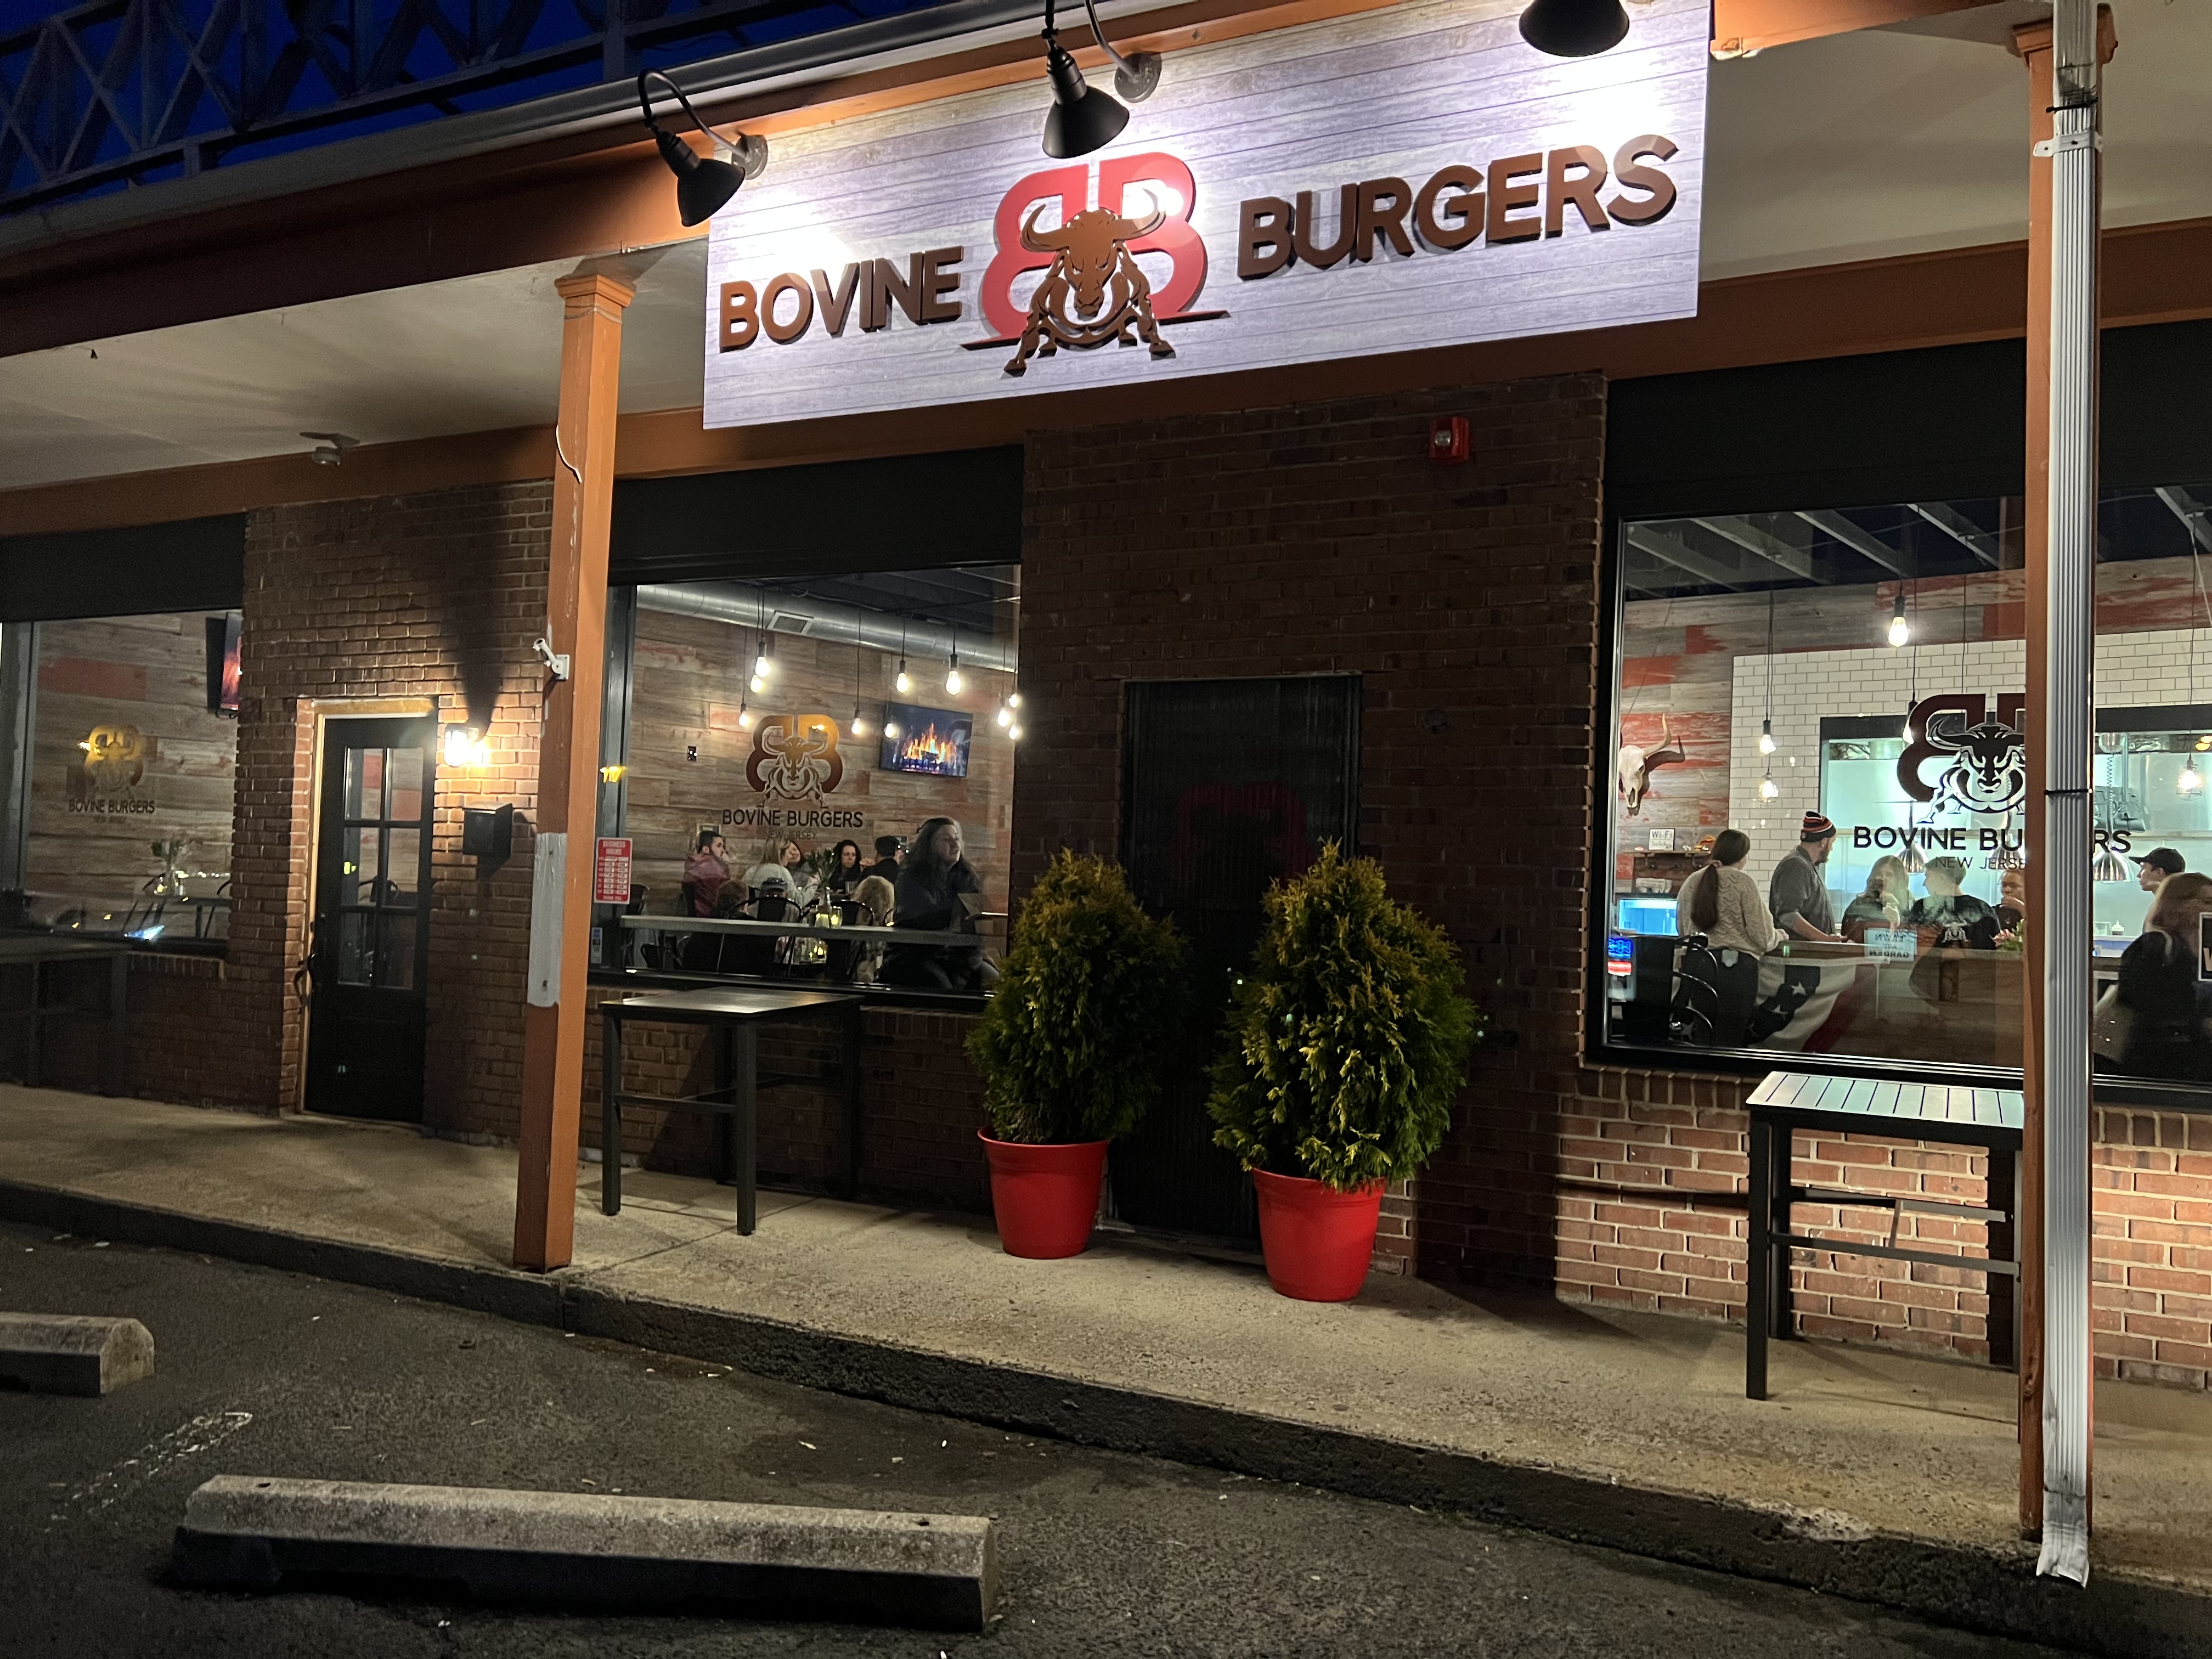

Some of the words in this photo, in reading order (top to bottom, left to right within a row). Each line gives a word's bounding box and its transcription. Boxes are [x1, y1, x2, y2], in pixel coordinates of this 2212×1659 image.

[719, 246, 964, 353] BOVINE
[1237, 134, 1680, 281] BURGERS
[69, 798, 106, 813] BOVINE
[108, 799, 155, 814] BURGERS
[722, 809, 781, 826] BOVINE
[787, 810, 864, 828] BURGERS
[765, 830, 784, 839] NEW
[785, 831, 817, 840] JERSEY
[1854, 826, 1967, 850] BOVINE
[1979, 827, 2132, 854] BURS
[1934, 856, 1973, 869] NEW
[1979, 857, 2026, 870] JERSE
